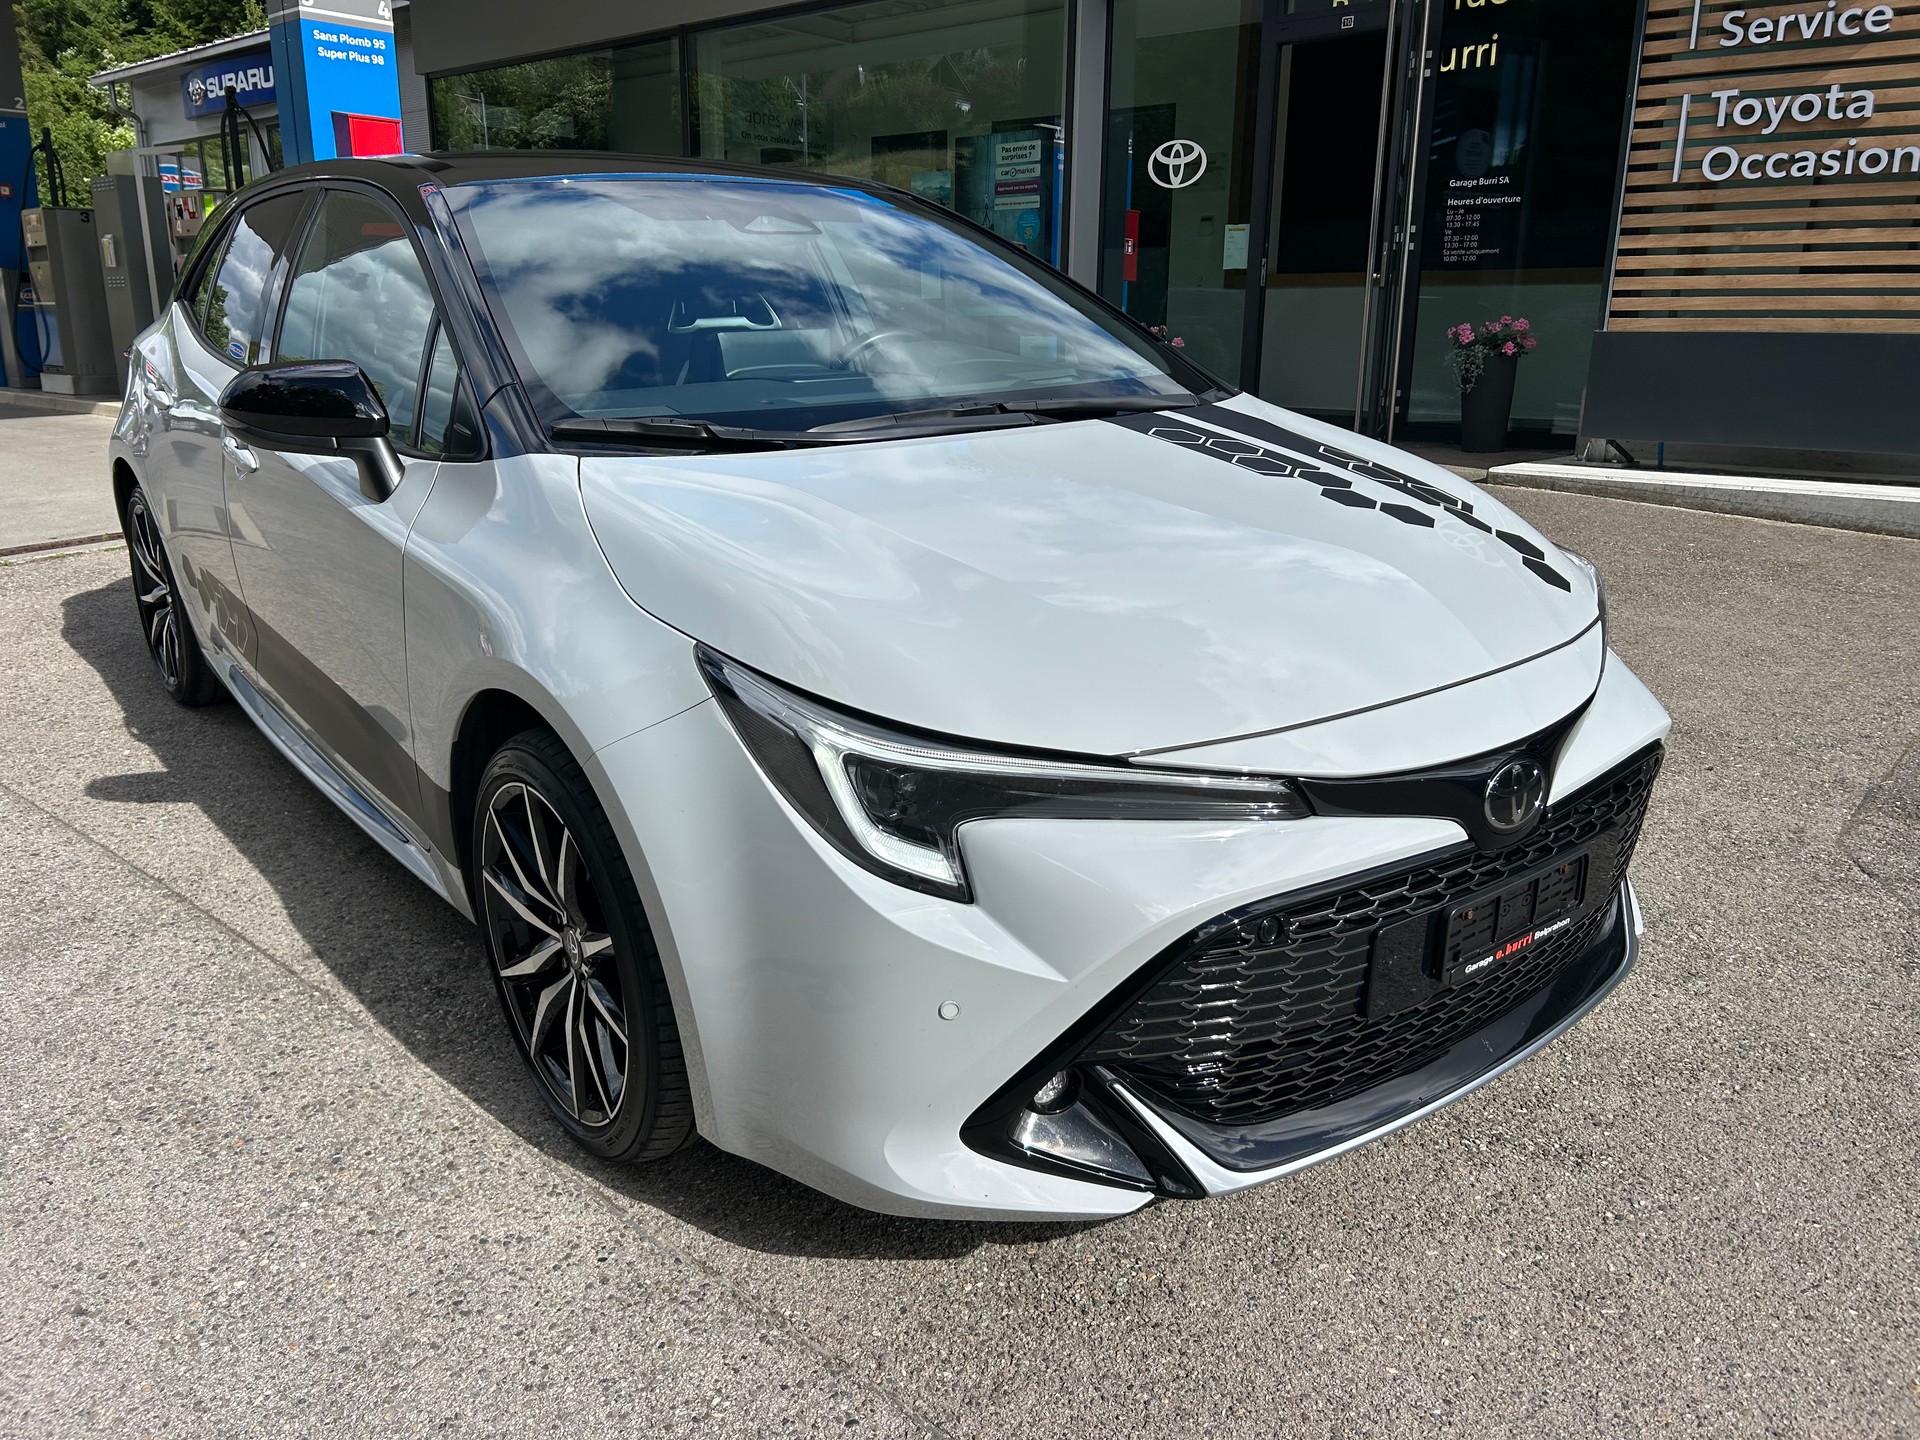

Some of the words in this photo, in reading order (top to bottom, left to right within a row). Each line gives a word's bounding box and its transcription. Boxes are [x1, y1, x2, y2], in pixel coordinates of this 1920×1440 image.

[378, 1, 391, 20] 4
[1719, 0, 1894, 47] Service
[312, 29, 339, 43] Sans
[339, 33, 372, 47] Plomb
[372, 38, 386, 50] 95
[317, 46, 347, 60] Super
[348, 51, 370, 63] Plus
[371, 55, 385, 66] 98
[1440, 33, 1498, 72] urri
[206, 65, 275, 99] SUBARU
[14, 97, 25, 109] 2
[1711, 84, 1876, 135] Toyota
[741, 130, 752, 139] On
[1001, 152, 1028, 161] surprises
[1702, 137, 1920, 182] Occasion
[1449, 179, 1478, 188] Garage
[1478, 176, 1498, 186] Burri
[1498, 175, 1510, 184] SA
[1447, 198, 1475, 206] Heures
[1475, 195, 1522, 205] d'ouverture
[80, 211, 91, 223] 3
[1464, 955, 1494, 974] Garage
